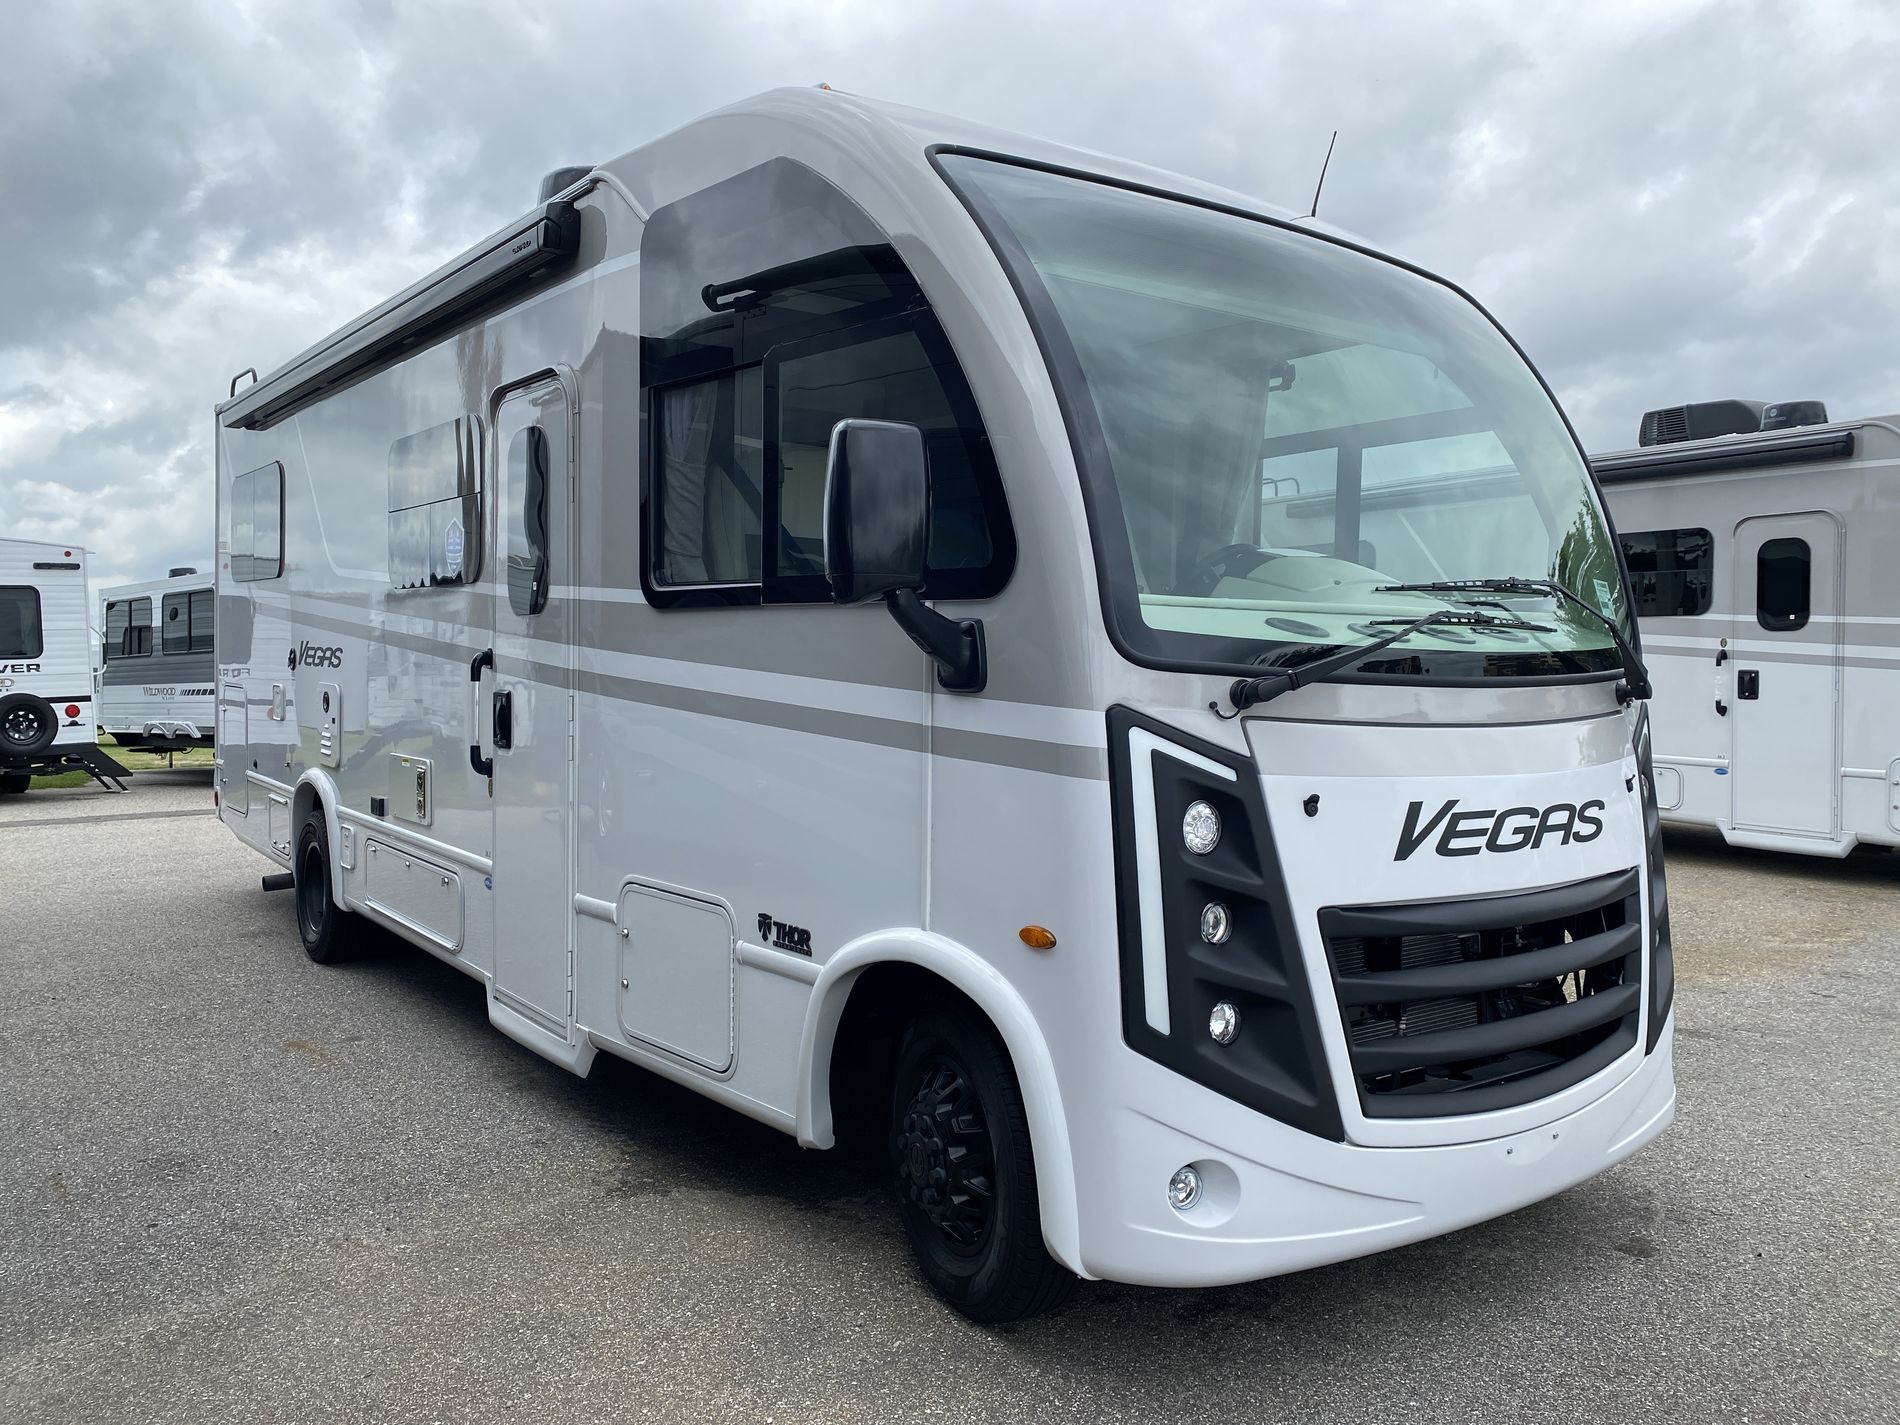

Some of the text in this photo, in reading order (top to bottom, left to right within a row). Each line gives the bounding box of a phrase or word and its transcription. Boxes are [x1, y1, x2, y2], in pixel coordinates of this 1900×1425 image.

[298, 640, 343, 668] VEGAS
[1393, 799, 1605, 861] VEGAS
[773, 920, 812, 951] THOR
